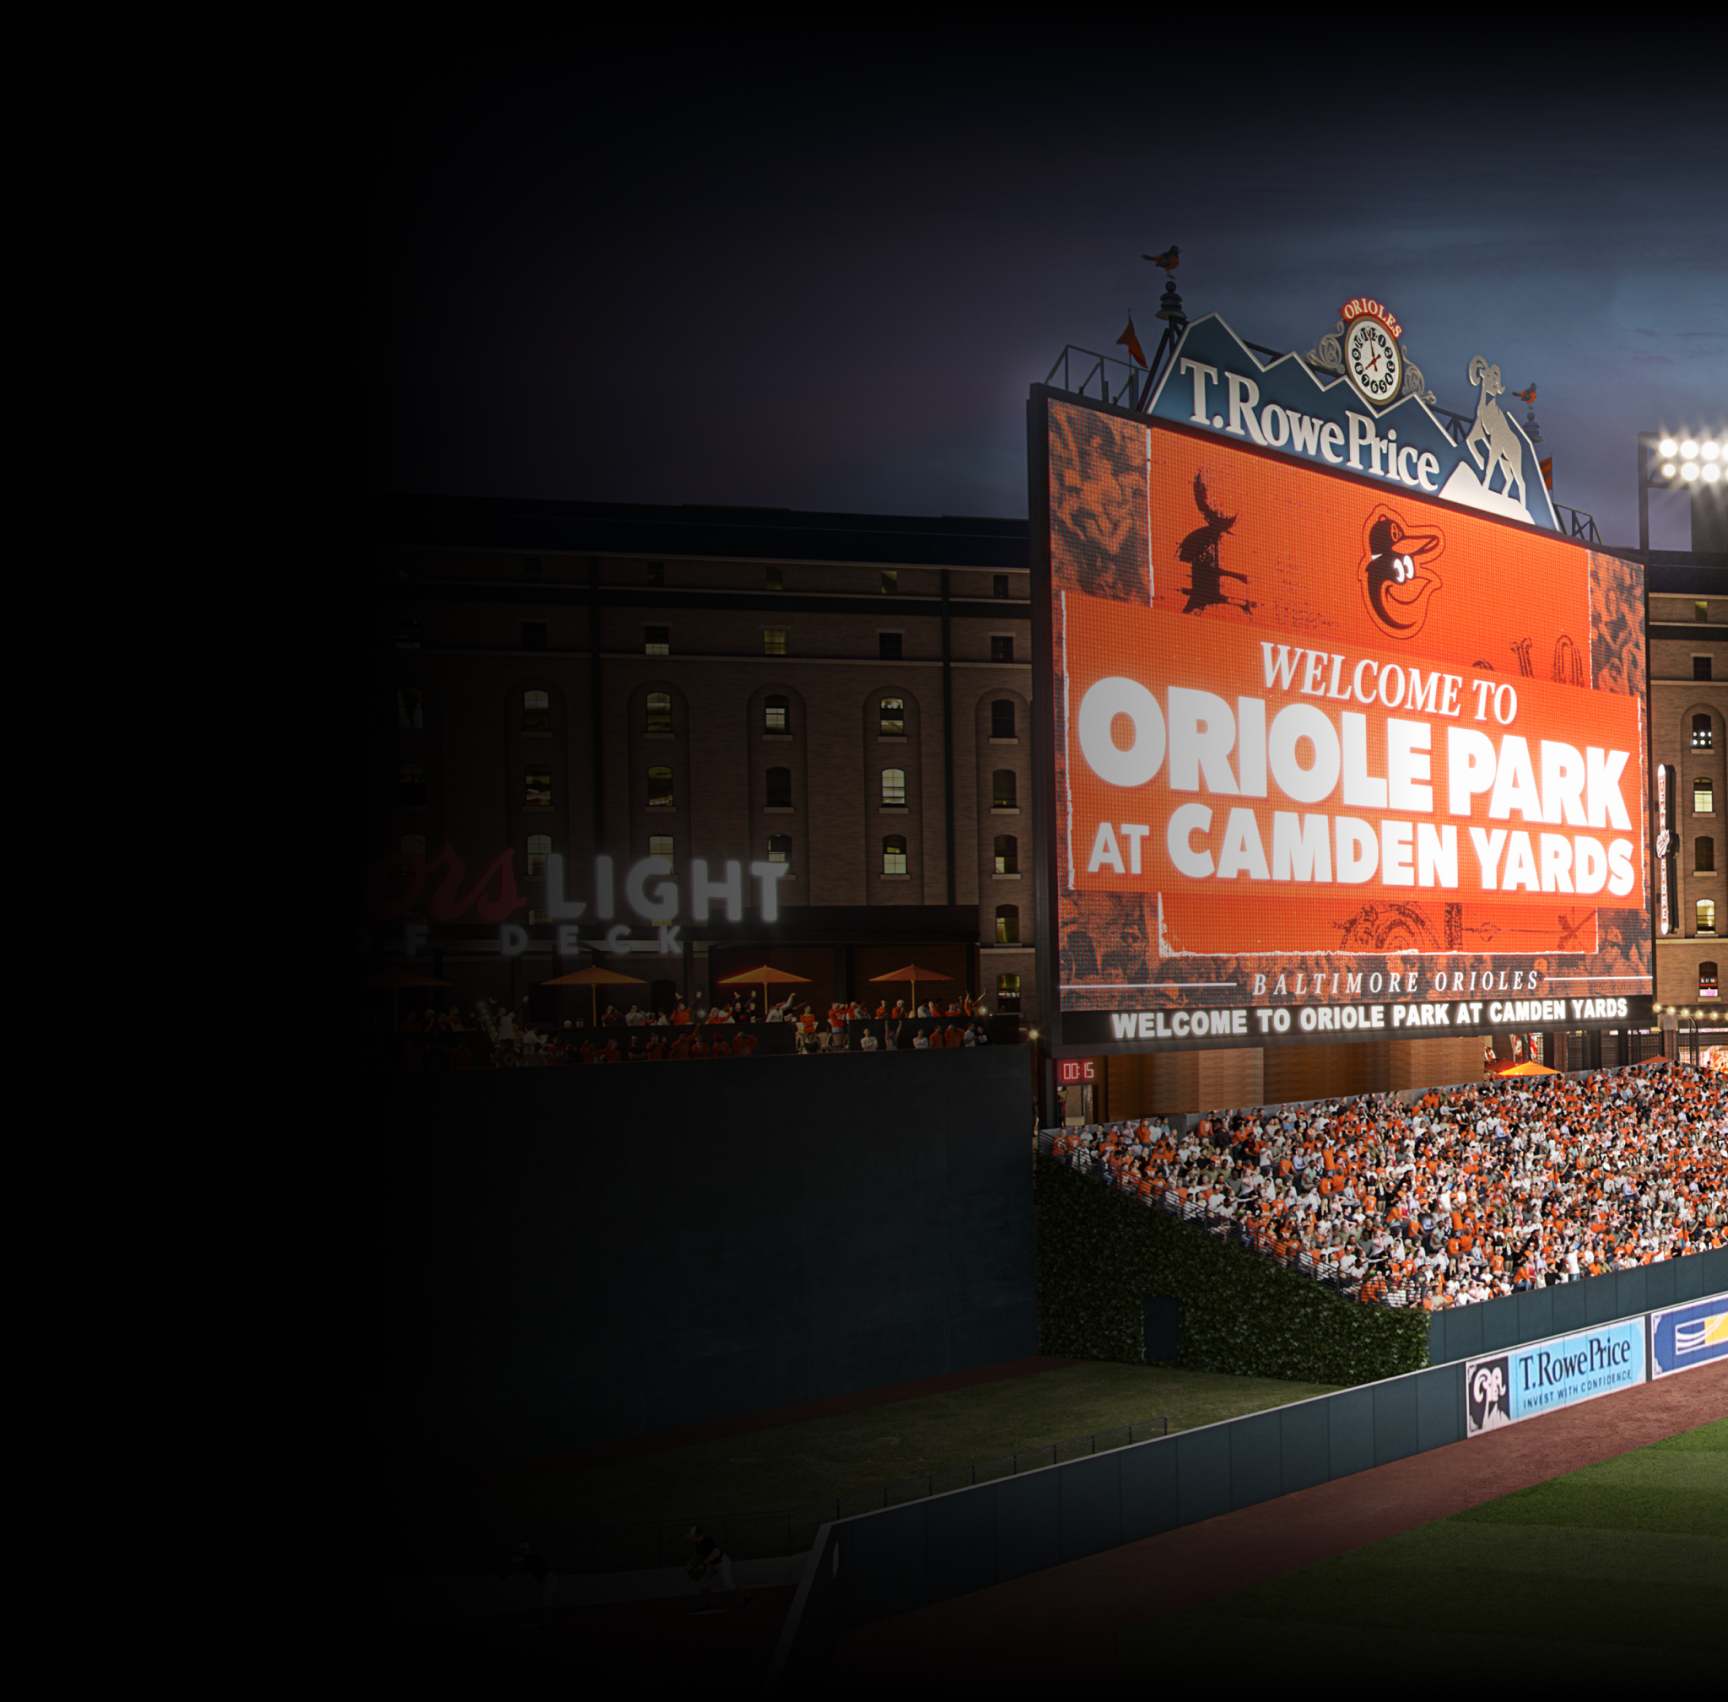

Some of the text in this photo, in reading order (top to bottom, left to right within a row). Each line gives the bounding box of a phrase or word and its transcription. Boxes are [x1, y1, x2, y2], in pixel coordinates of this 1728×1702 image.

[1344, 298, 1402, 338] ORIOLES
[1261, 641, 1517, 724] WELCOME TO
[1078, 676, 1633, 831] ORIOLE PARK
[1087, 803, 1635, 896] AT CAMDEN YARDS
[545, 853, 790, 922] LIGHT
[502, 924, 683, 957] DECK
[1252, 968, 1540, 997] BALTIMORE ORIOLES
[1112, 998, 1628, 1039] WELCOME TO ORIOLE PARK AT CAMDEN YARDS
[1063, 1062, 1094, 1079] 00:15
[1523, 1368, 1632, 1410] INVEST WITH CONFIDENCE
